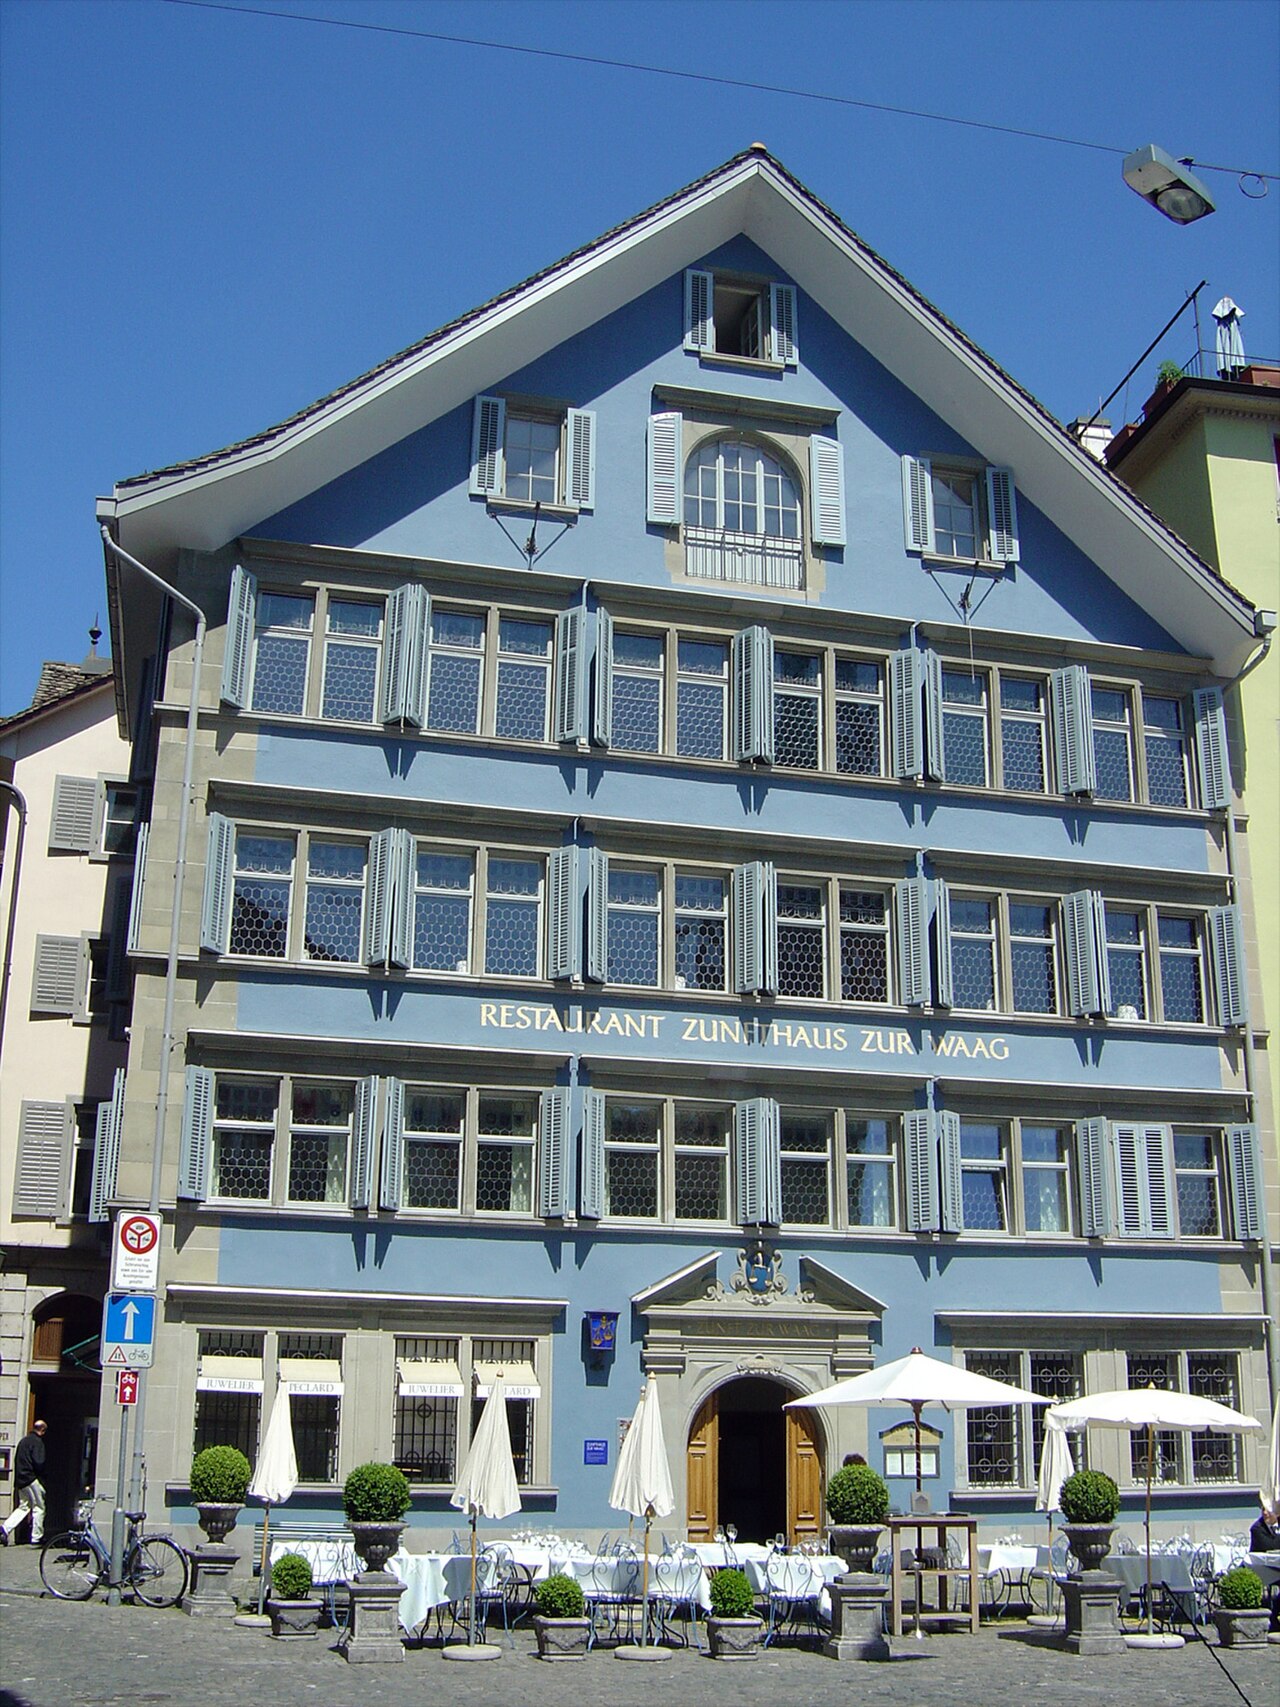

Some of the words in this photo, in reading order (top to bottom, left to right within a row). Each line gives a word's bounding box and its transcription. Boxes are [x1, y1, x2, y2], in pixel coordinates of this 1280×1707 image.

[480, 1003, 666, 1039] RESTAURANT
[682, 1017, 848, 1051] ZUNFTHAUS
[860, 1030, 915, 1055] ZUR
[929, 1035, 1010, 1060] WAAG
[747, 1322, 775, 1337] ZUR
[778, 1323, 820, 1338] WAAG
[206, 1379, 255, 1390] JUWELIER
[408, 1384, 456, 1395] JUWELIER
